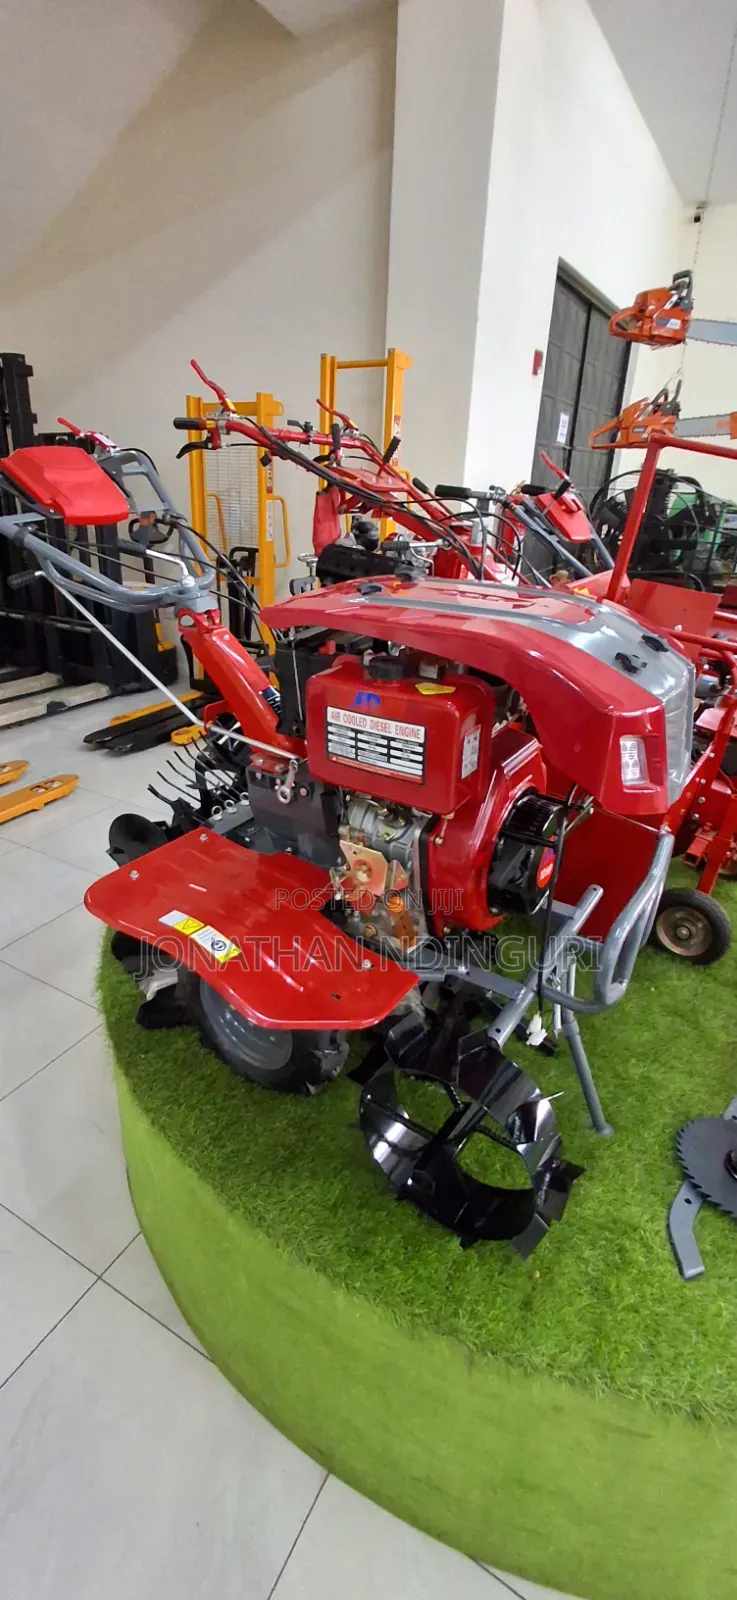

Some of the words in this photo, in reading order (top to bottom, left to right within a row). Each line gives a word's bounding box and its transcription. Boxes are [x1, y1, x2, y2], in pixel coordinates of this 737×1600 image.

[330, 711, 340, 720] AIR
[343, 713, 367, 728] COOLED
[370, 719, 391, 734] DIESEL
[395, 725, 421, 740] ENGINE
